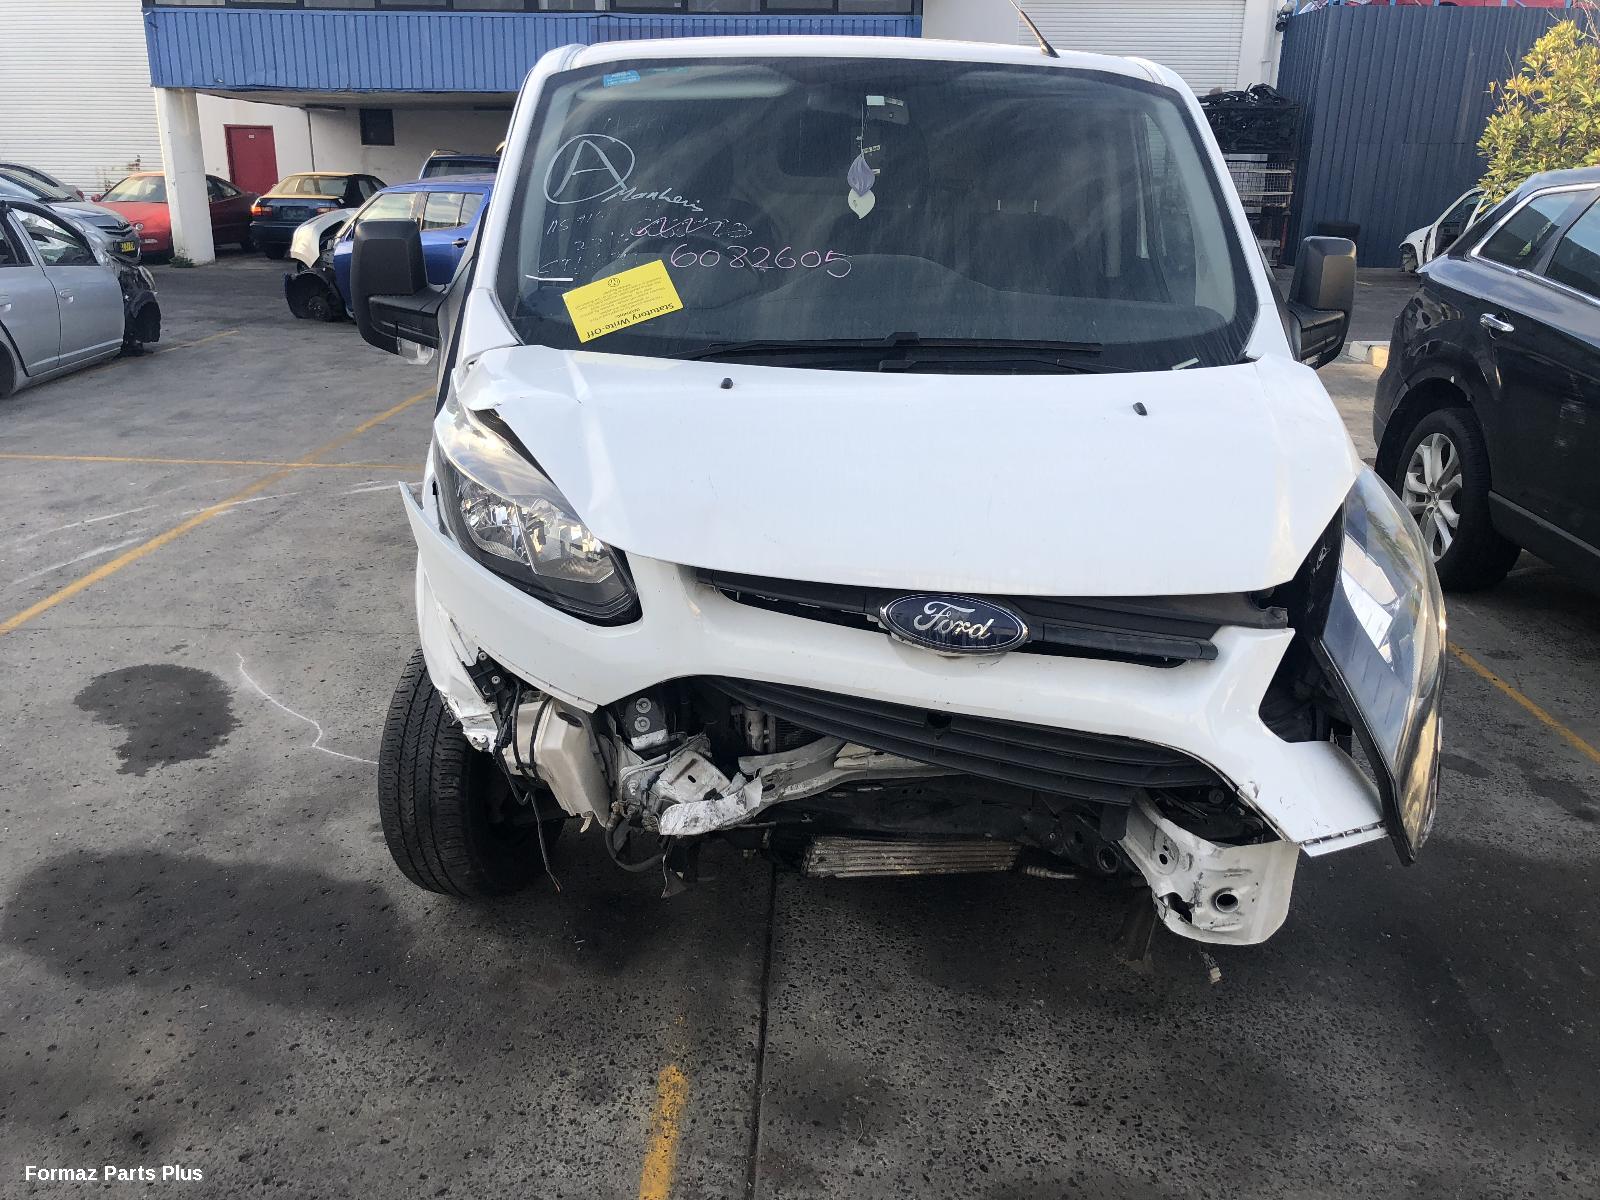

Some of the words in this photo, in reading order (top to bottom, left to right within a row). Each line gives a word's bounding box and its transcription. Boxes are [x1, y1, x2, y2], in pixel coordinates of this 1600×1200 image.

[670, 243, 852, 278] 6082605
[632, 302, 675, 322] Statutory
[586, 319, 631, 339] Write-Off
[913, 600, 995, 640] Ford
